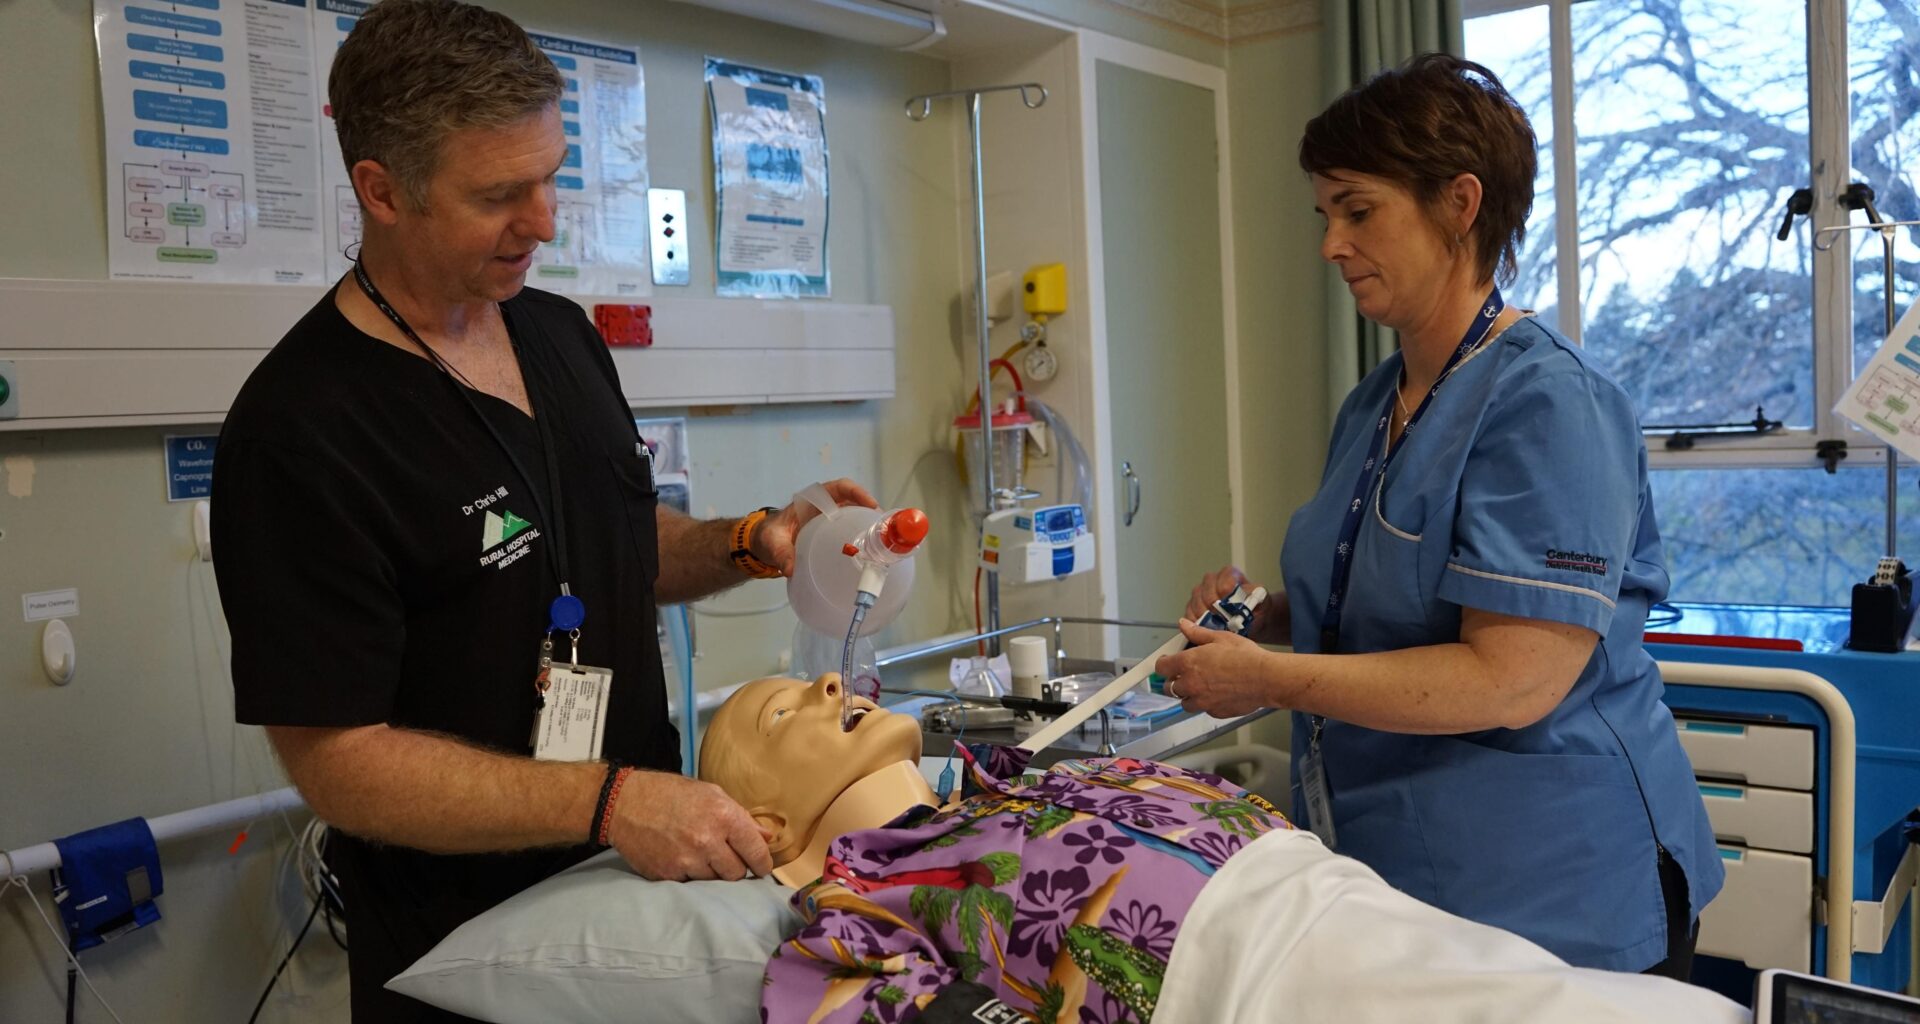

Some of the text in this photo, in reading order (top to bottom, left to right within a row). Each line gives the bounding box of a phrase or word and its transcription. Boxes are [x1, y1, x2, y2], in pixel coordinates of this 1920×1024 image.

[462, 485, 509, 516] Dr Chris Hill
[480, 528, 541, 567] RURAL HOSPITAL
[498, 544, 531, 570] MEDICINE
[1546, 549, 1607, 567] Canterbury
